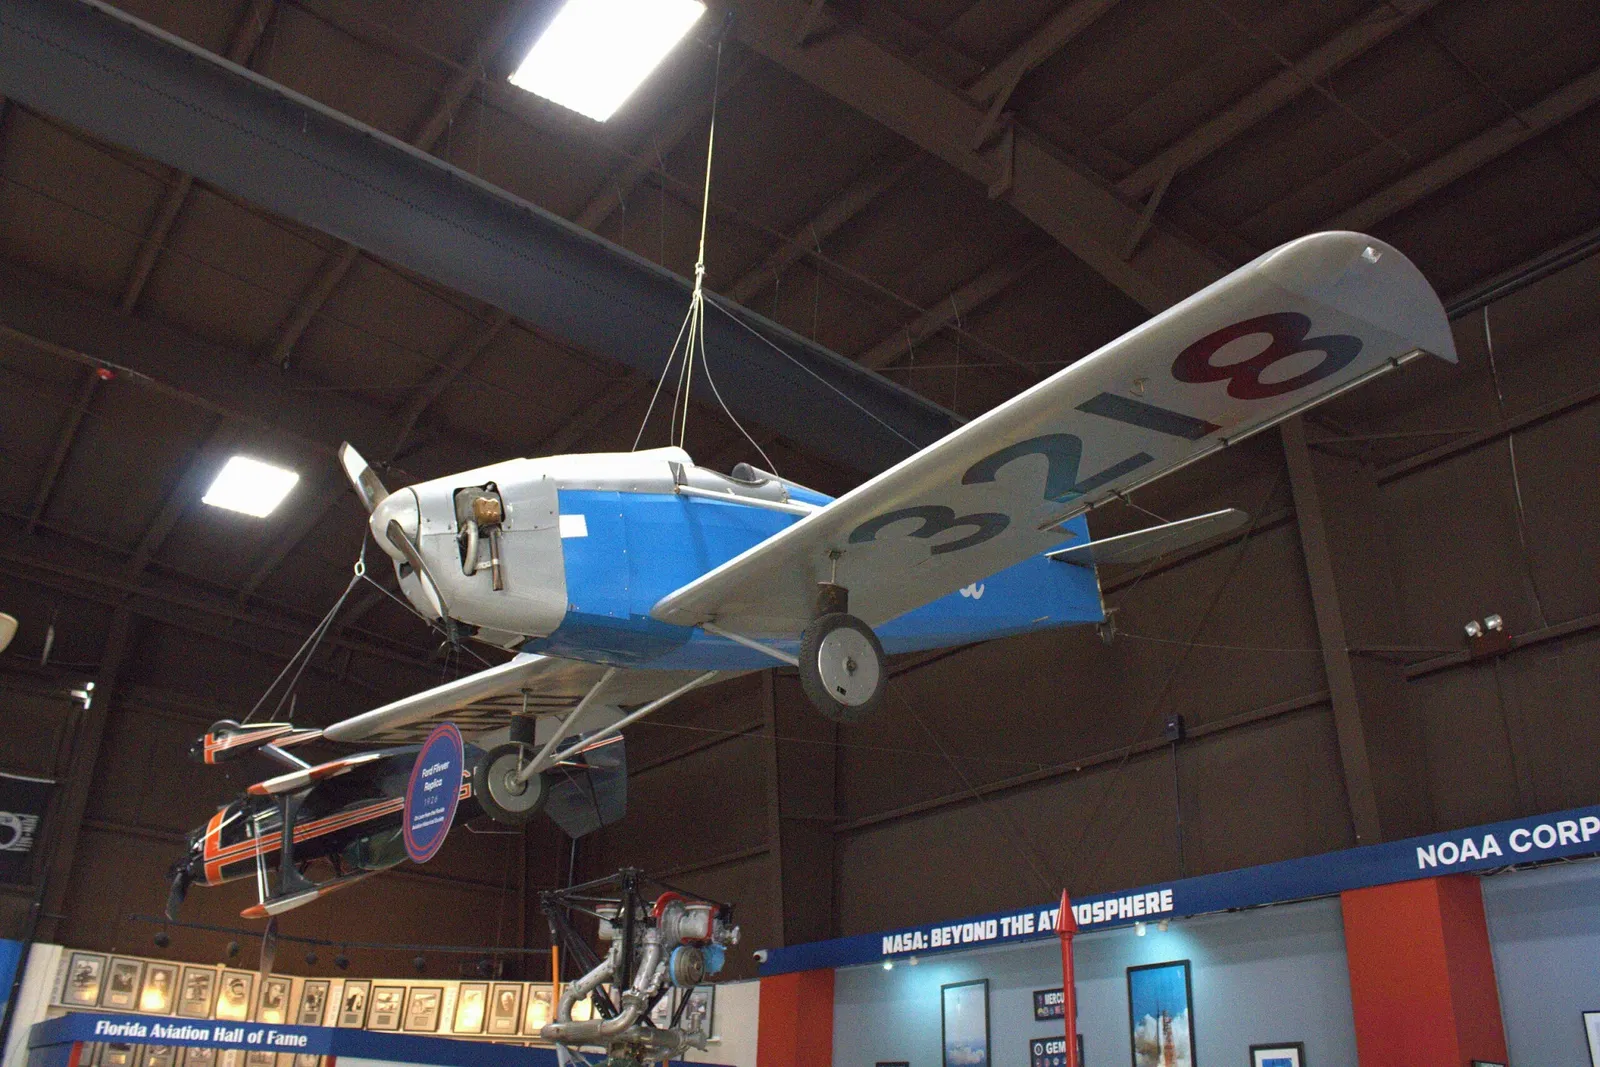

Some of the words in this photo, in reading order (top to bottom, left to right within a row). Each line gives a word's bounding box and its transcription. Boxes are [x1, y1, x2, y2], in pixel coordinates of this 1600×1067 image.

[848, 311, 1363, 556] 3218
[424, 778, 443, 792] Replica
[1416, 834, 1503, 869] NOAA
[1509, 816, 1600, 853] CORP
[882, 931, 929, 954] NASA:
[931, 919, 997, 947] BEYOND
[1000, 913, 1034, 937] THE
[95, 1020, 147, 1037] Florida
[150, 1023, 209, 1041] Aviation
[213, 1026, 243, 1043] Hall
[247, 1029, 264, 1044] of
[267, 1030, 307, 1047] Fame
